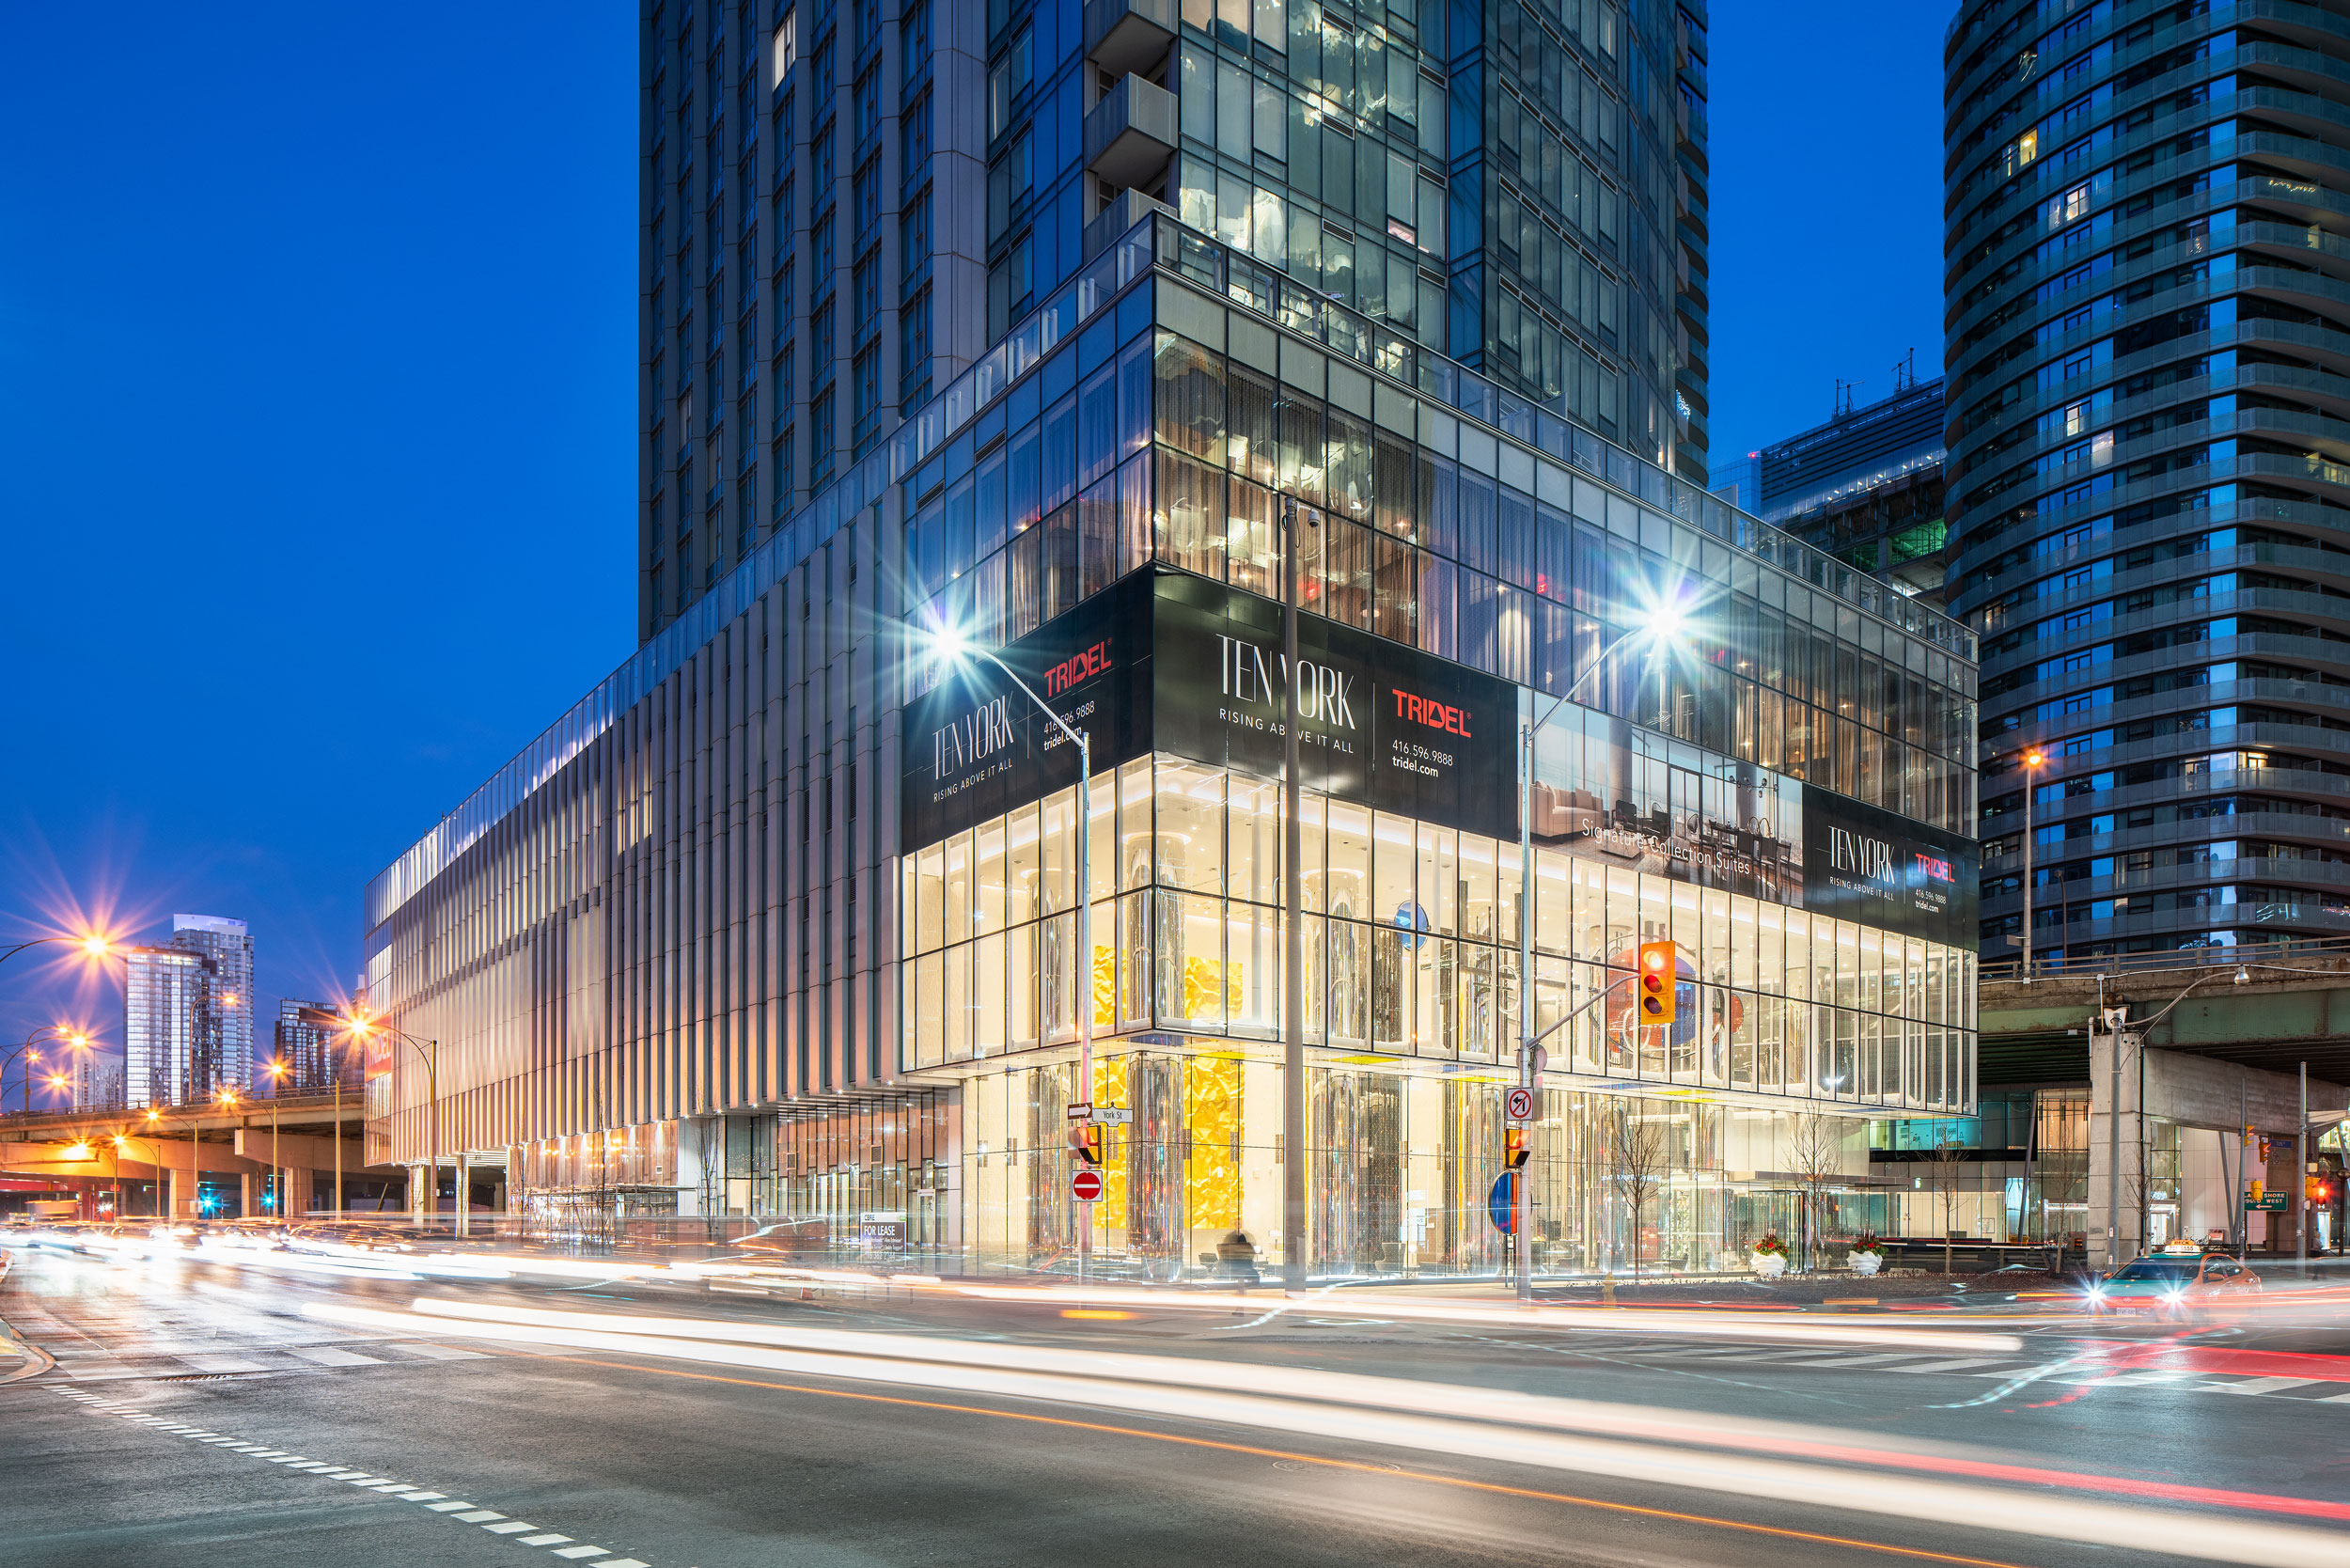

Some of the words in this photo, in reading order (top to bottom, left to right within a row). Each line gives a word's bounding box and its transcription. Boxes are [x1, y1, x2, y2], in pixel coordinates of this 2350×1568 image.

[1044, 641, 1112, 698] TRIDEL
[1215, 634, 1273, 707] TEN
[1392, 688, 1472, 738] TRIDEL
[932, 718, 963, 781] TEN
[966, 691, 1014, 764] YORK
[1043, 726, 1082, 751] tridel.cm
[1219, 708, 1263, 730] RISING
[1269, 722, 1311, 743] ABVE
[1317, 734, 1327, 746] IT
[1333, 739, 1355, 754] ALL
[1392, 739, 1453, 766] 416.596.9888
[1392, 755, 1439, 777] tridel.com
[933, 783, 958, 803] RISING
[960, 770, 985, 790] ABOVE
[988, 765, 995, 778] IT
[998, 758, 1013, 773] ALL
[1582, 818, 1645, 850] Signature
[1651, 835, 1712, 865] Collection
[1716, 851, 1750, 875] Suites
[1827, 825, 1856, 873] TEN
[1857, 835, 1896, 885] YORK
[1915, 853, 1956, 883] TRIDEL
[1829, 876, 1852, 889] RISING
[1853, 883, 1874, 896] ABOVE
[1876, 888, 1882, 898] IT
[1884, 891, 1895, 902] ALL
[1915, 888, 1947, 905] 416.596.9888
[1915, 900, 1939, 914] tridel.com
[1103, 1111, 1116, 1120] York
[1117, 1111, 1122, 1120] St
[864, 1225, 876, 1236] FOR
[877, 1225, 896, 1236] LEASE
